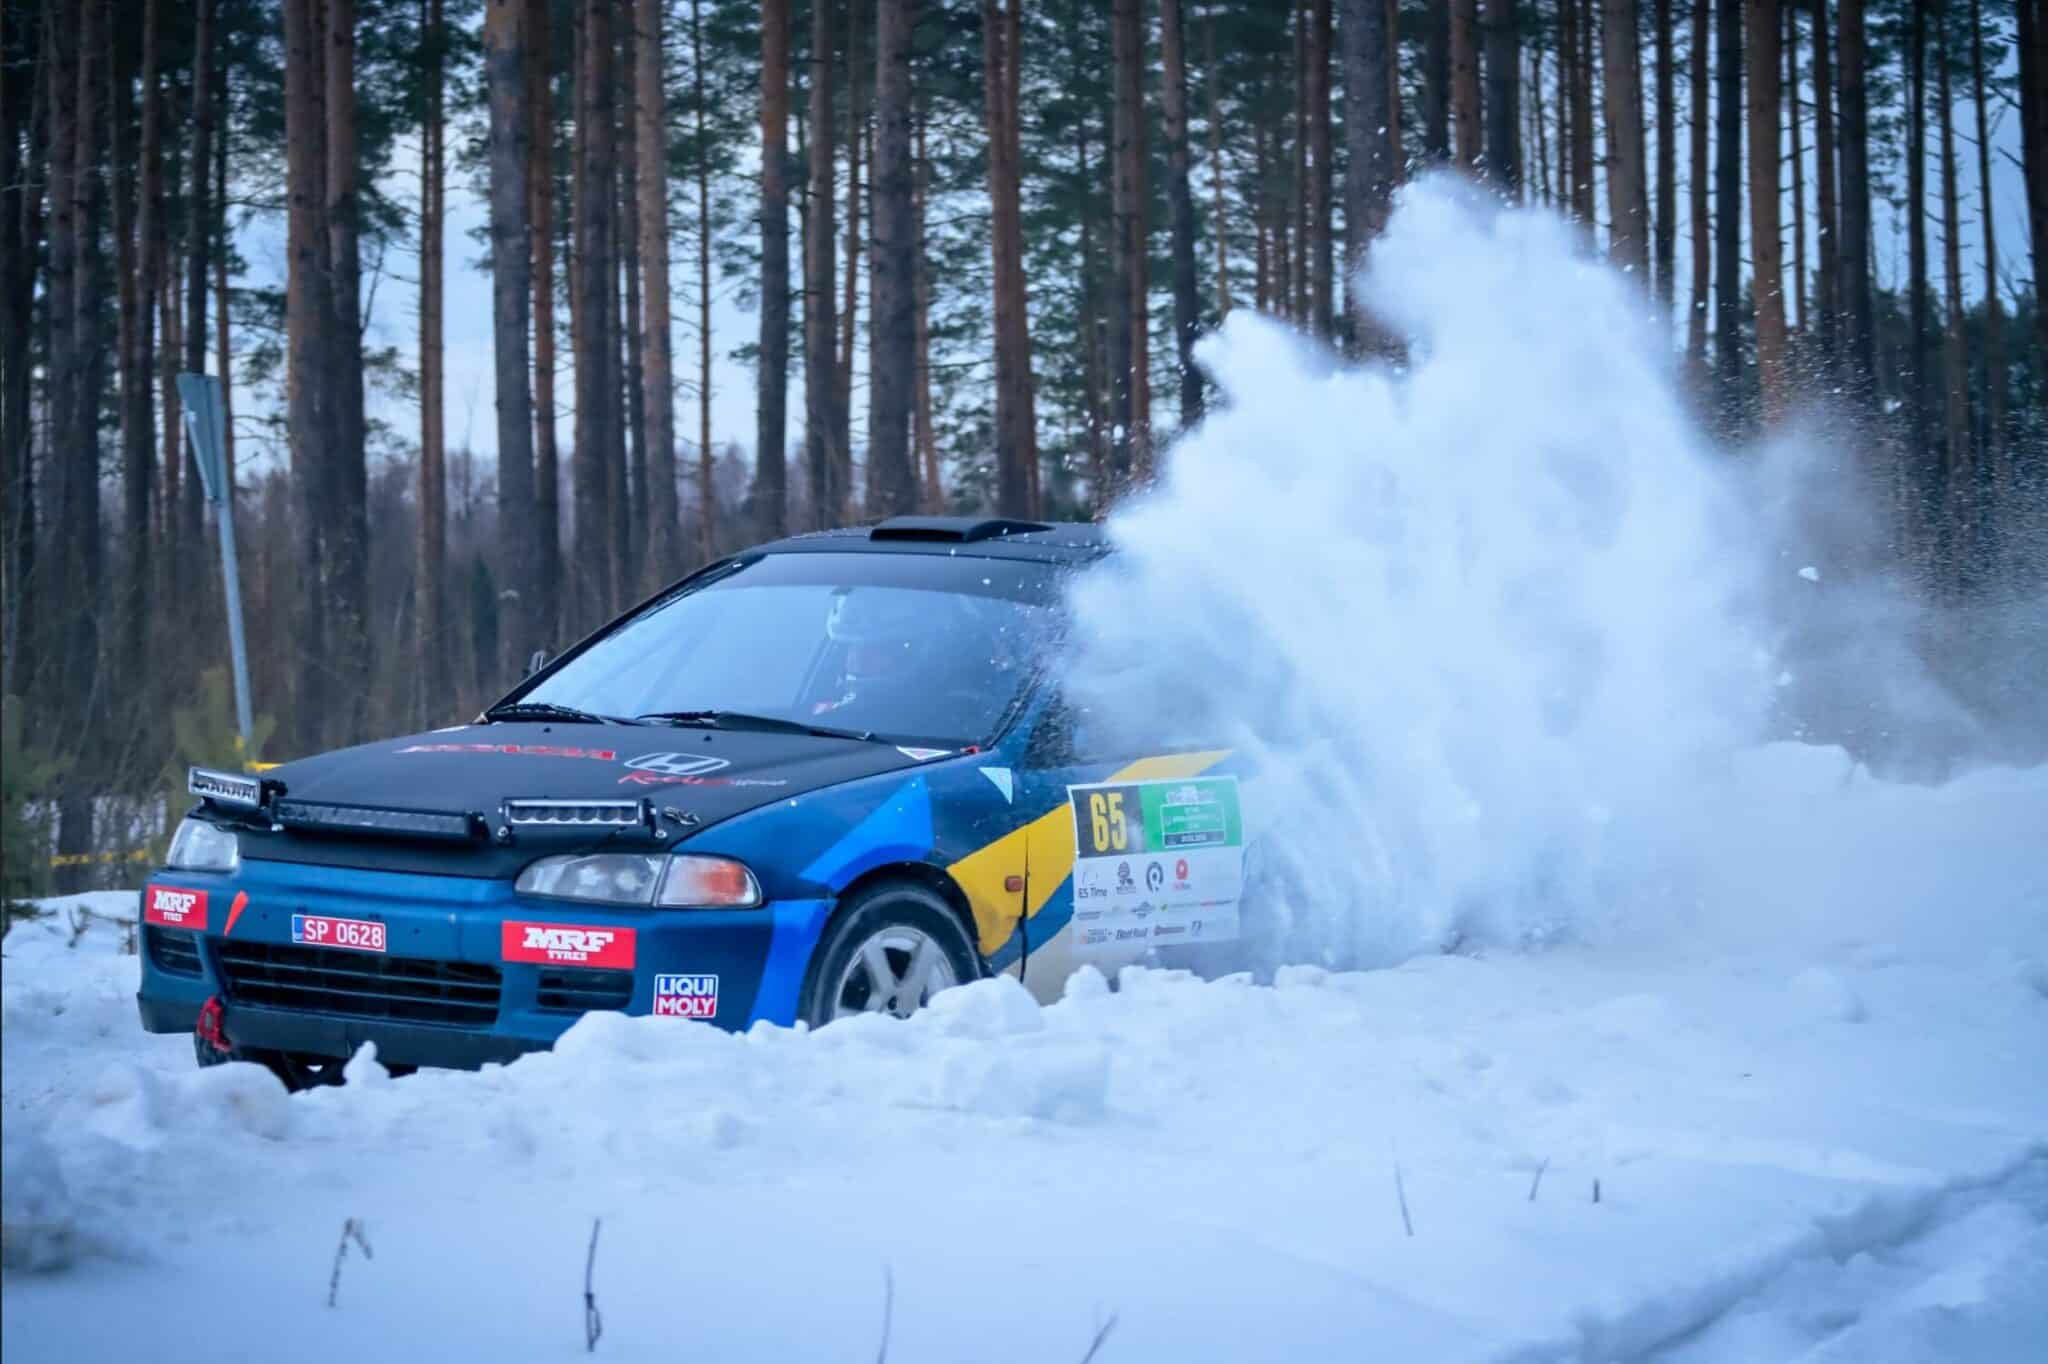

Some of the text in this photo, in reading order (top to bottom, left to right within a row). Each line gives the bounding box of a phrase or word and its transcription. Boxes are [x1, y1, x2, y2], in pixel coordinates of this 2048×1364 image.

[1089, 793, 1127, 852] 65
[153, 890, 196, 913] MRF
[304, 919, 382, 947] SP 0628
[523, 928, 614, 952] MRF
[548, 951, 587, 961] TYRES
[659, 978, 714, 995] LIQUI
[658, 998, 714, 1016] MOLY
